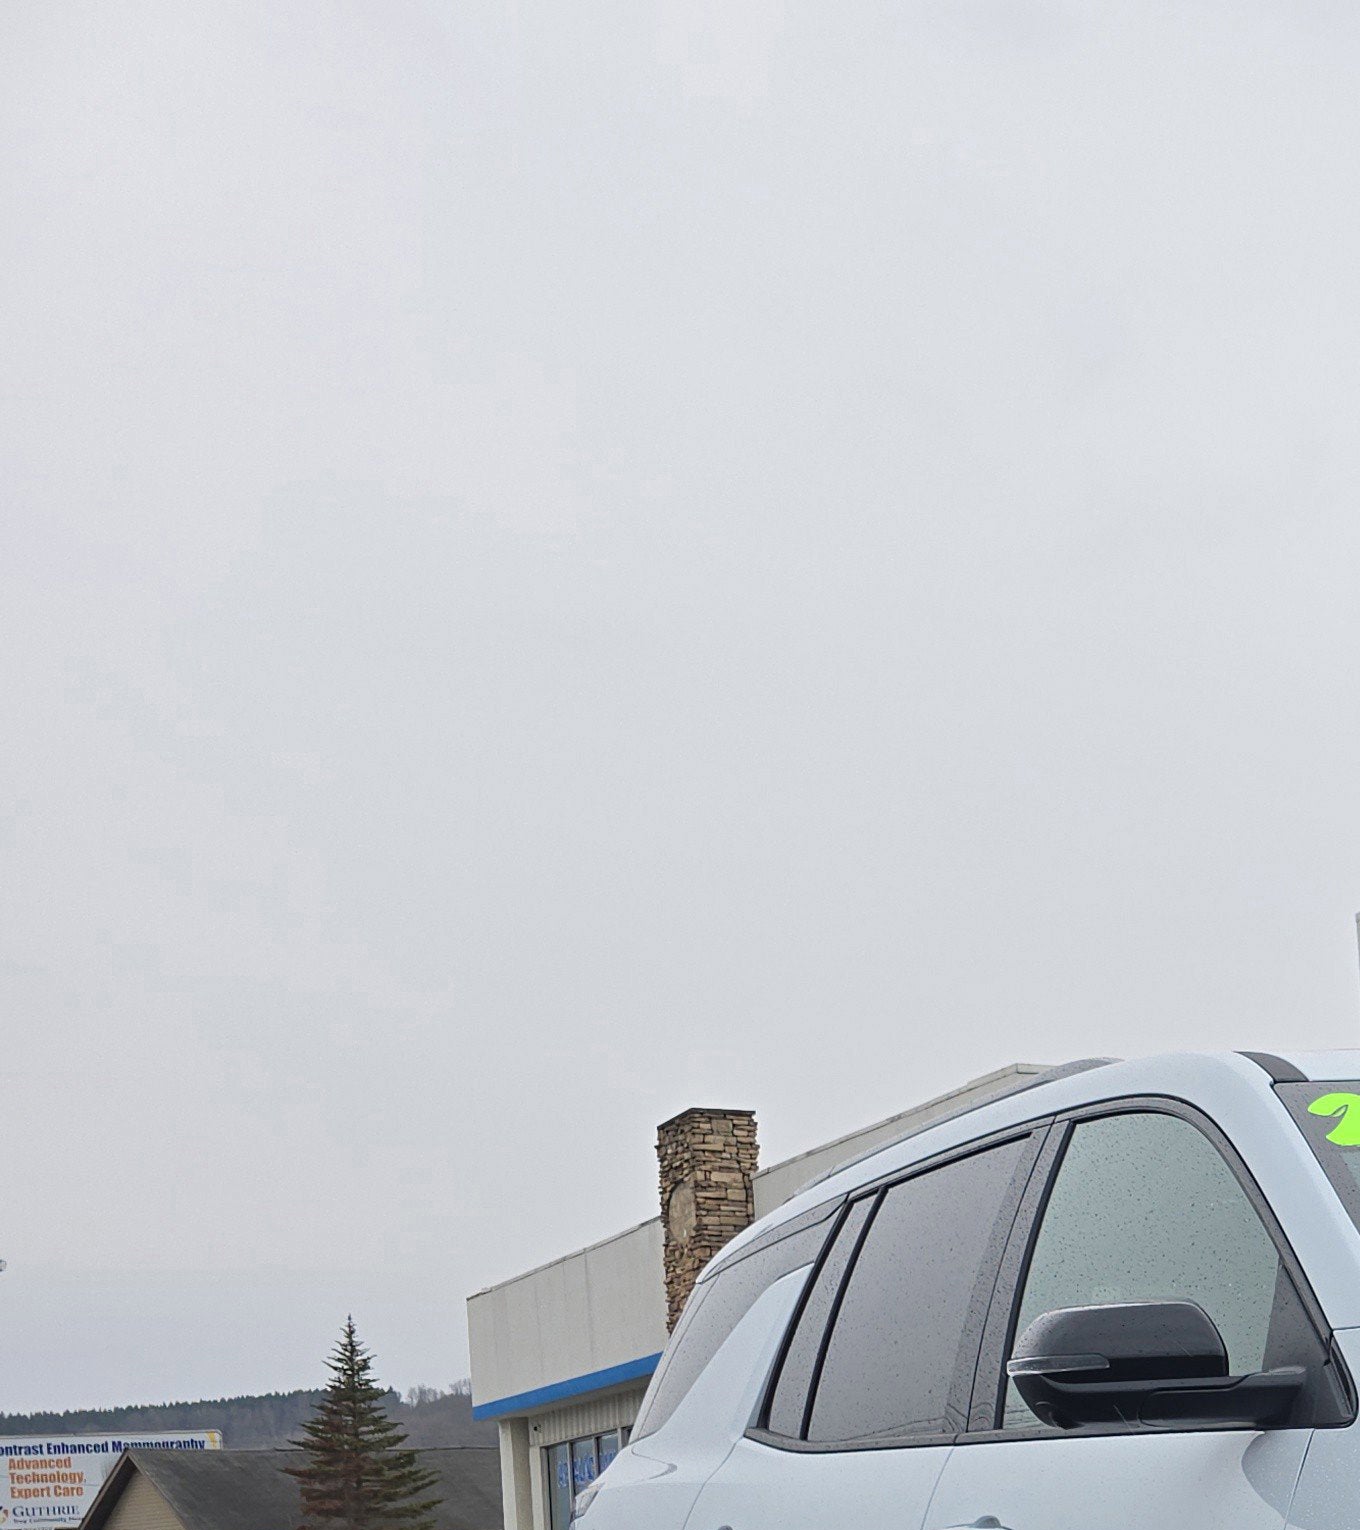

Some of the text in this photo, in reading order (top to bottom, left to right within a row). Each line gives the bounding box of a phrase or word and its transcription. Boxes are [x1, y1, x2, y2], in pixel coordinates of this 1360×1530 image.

[0, 1443, 44, 1457] ontrast
[46, 1440, 109, 1455] Enhanced
[9, 1456, 72, 1470] Advanced
[10, 1485, 84, 1499] Expert Care
